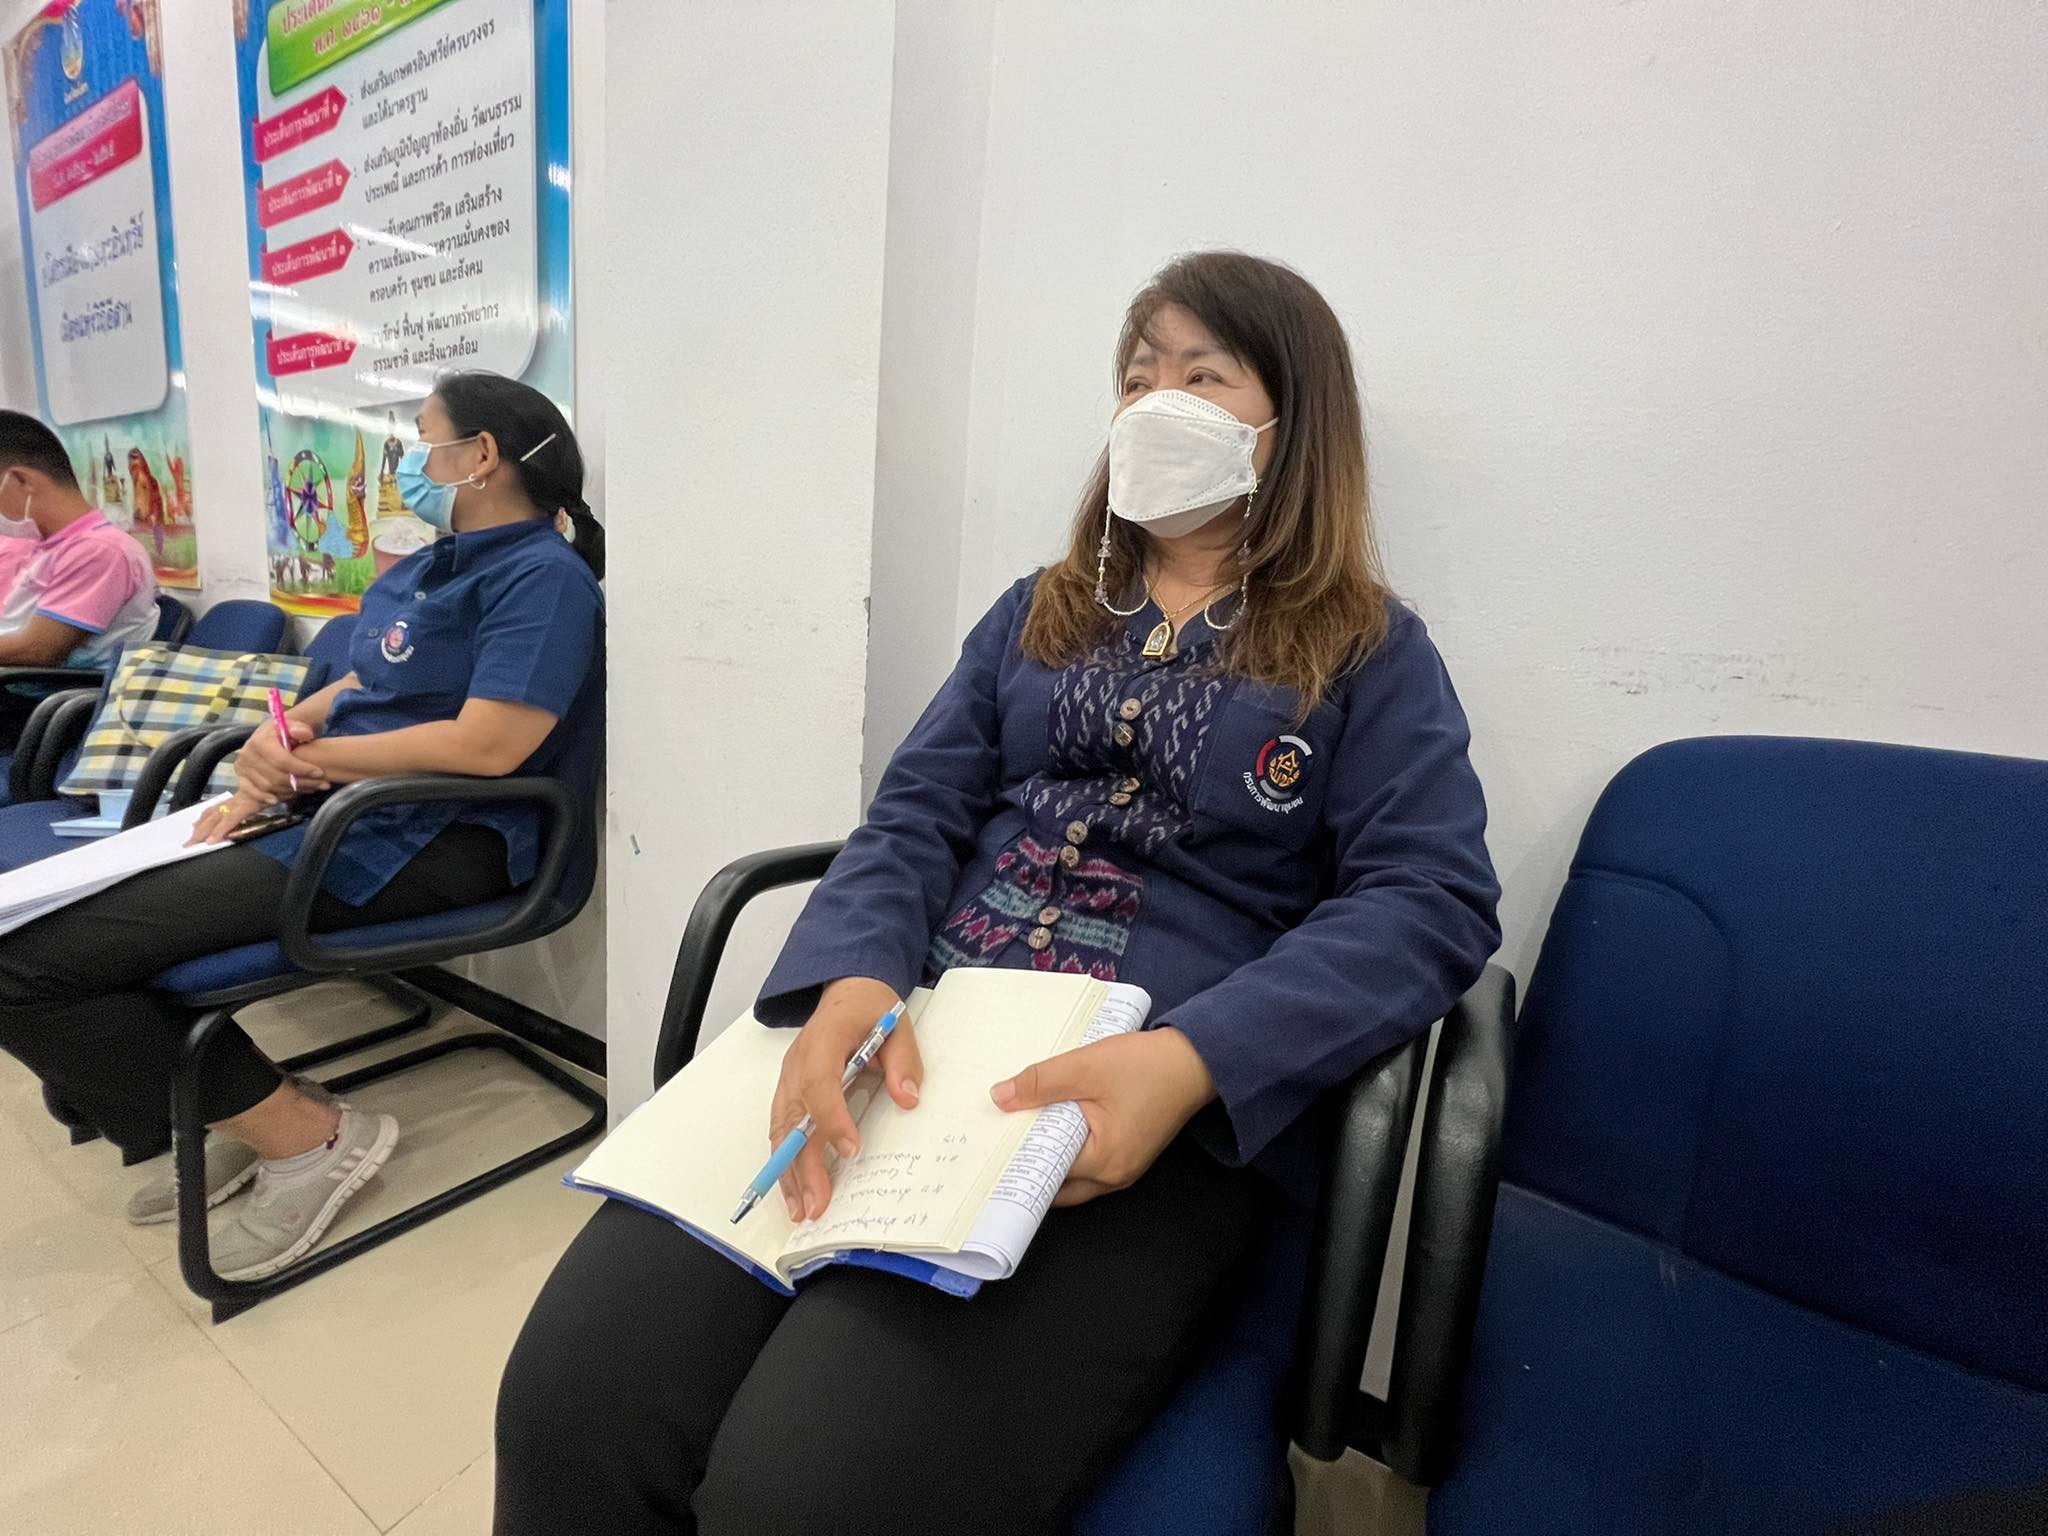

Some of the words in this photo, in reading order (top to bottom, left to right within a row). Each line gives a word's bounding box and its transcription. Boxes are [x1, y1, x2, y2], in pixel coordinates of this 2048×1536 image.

[360, 18, 495, 100] ส่งเสริมเกษตรอินทรีย์ครบวงจร
[362, 86, 428, 129] และได้มาตรฐาน
[363, 107, 468, 174] ส่งเสริมภูมิปัญญาท้องถิ่น
[472, 94, 522, 128] วัฒนธรรม
[365, 170, 399, 203] ประเพณี
[402, 153, 448, 189] และการค้า
[451, 126, 515, 171] การท่องเที่ยว
[455, 183, 502, 217] เสริมสร้าง
[369, 275, 408, 303] ครอบครัว
[410, 272, 436, 298] ชุมชน
[440, 257, 483, 284] และสังคม
[402, 312, 424, 341] ฟื้นฟู
[426, 303, 499, 332] พัฒนาทรัพยากร
[276, 338, 342, 365] ประเด็นการพัฒนาท
[373, 348, 409, 372] ธรรมชาติ
[412, 336, 479, 365] และสิ่งแวดล้อม
